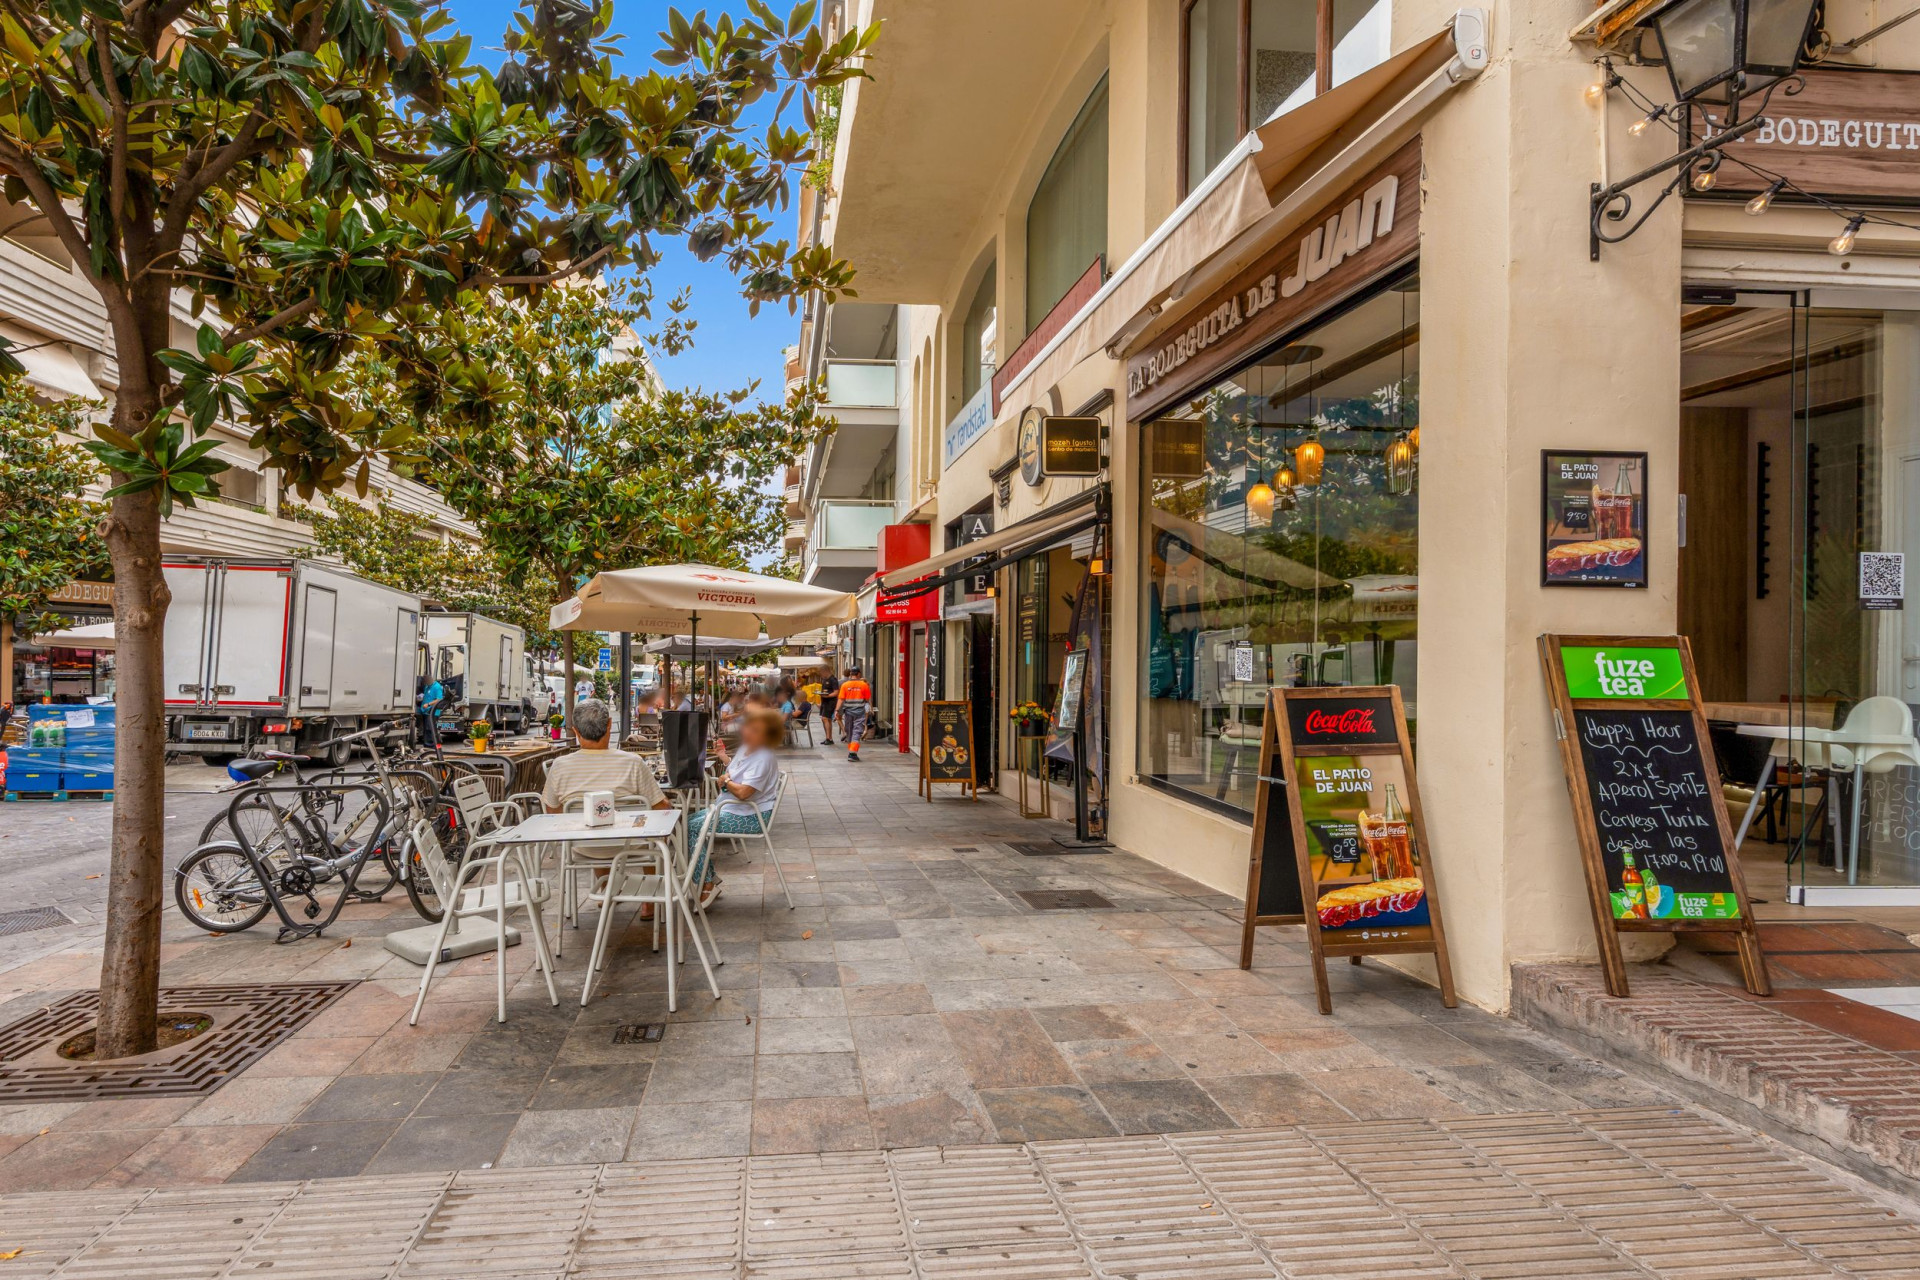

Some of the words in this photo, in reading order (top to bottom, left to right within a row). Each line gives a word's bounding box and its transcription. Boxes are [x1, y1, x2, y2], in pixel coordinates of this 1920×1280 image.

[1755, 116, 1920, 150] BODEGUIT
[1128, 367, 1147, 399] LA
[1147, 295, 1243, 386] BODEGUITA
[1245, 273, 1276, 318] DE
[957, 391, 987, 449] randstad
[1561, 463, 1572, 471] EL
[1573, 463, 1599, 471] PATIO
[1561, 471, 1574, 479] DE
[1574, 472, 1598, 480] JUAN
[697, 592, 757, 605] VICTORIA
[73, 615, 86, 626] LA
[1594, 651, 1656, 677] fuze
[1598, 675, 1646, 696] tea
[1305, 708, 1377, 734] Coca-Cola
[1585, 716, 1635, 744] Happy
[1641, 716, 1681, 738] Hour
[1313, 769, 1331, 780] EL
[1332, 768, 1371, 780] PATIO
[1316, 782, 1335, 793] DE
[1337, 781, 1373, 793] JUAN
[1599, 779, 1654, 806] Aperol
[1600, 809, 1659, 832] Cerveza
[1607, 832, 1652, 852] desde
[1666, 831, 1698, 850] las
[1678, 894, 1708, 907] fuze
[1680, 905, 1703, 917] tea
